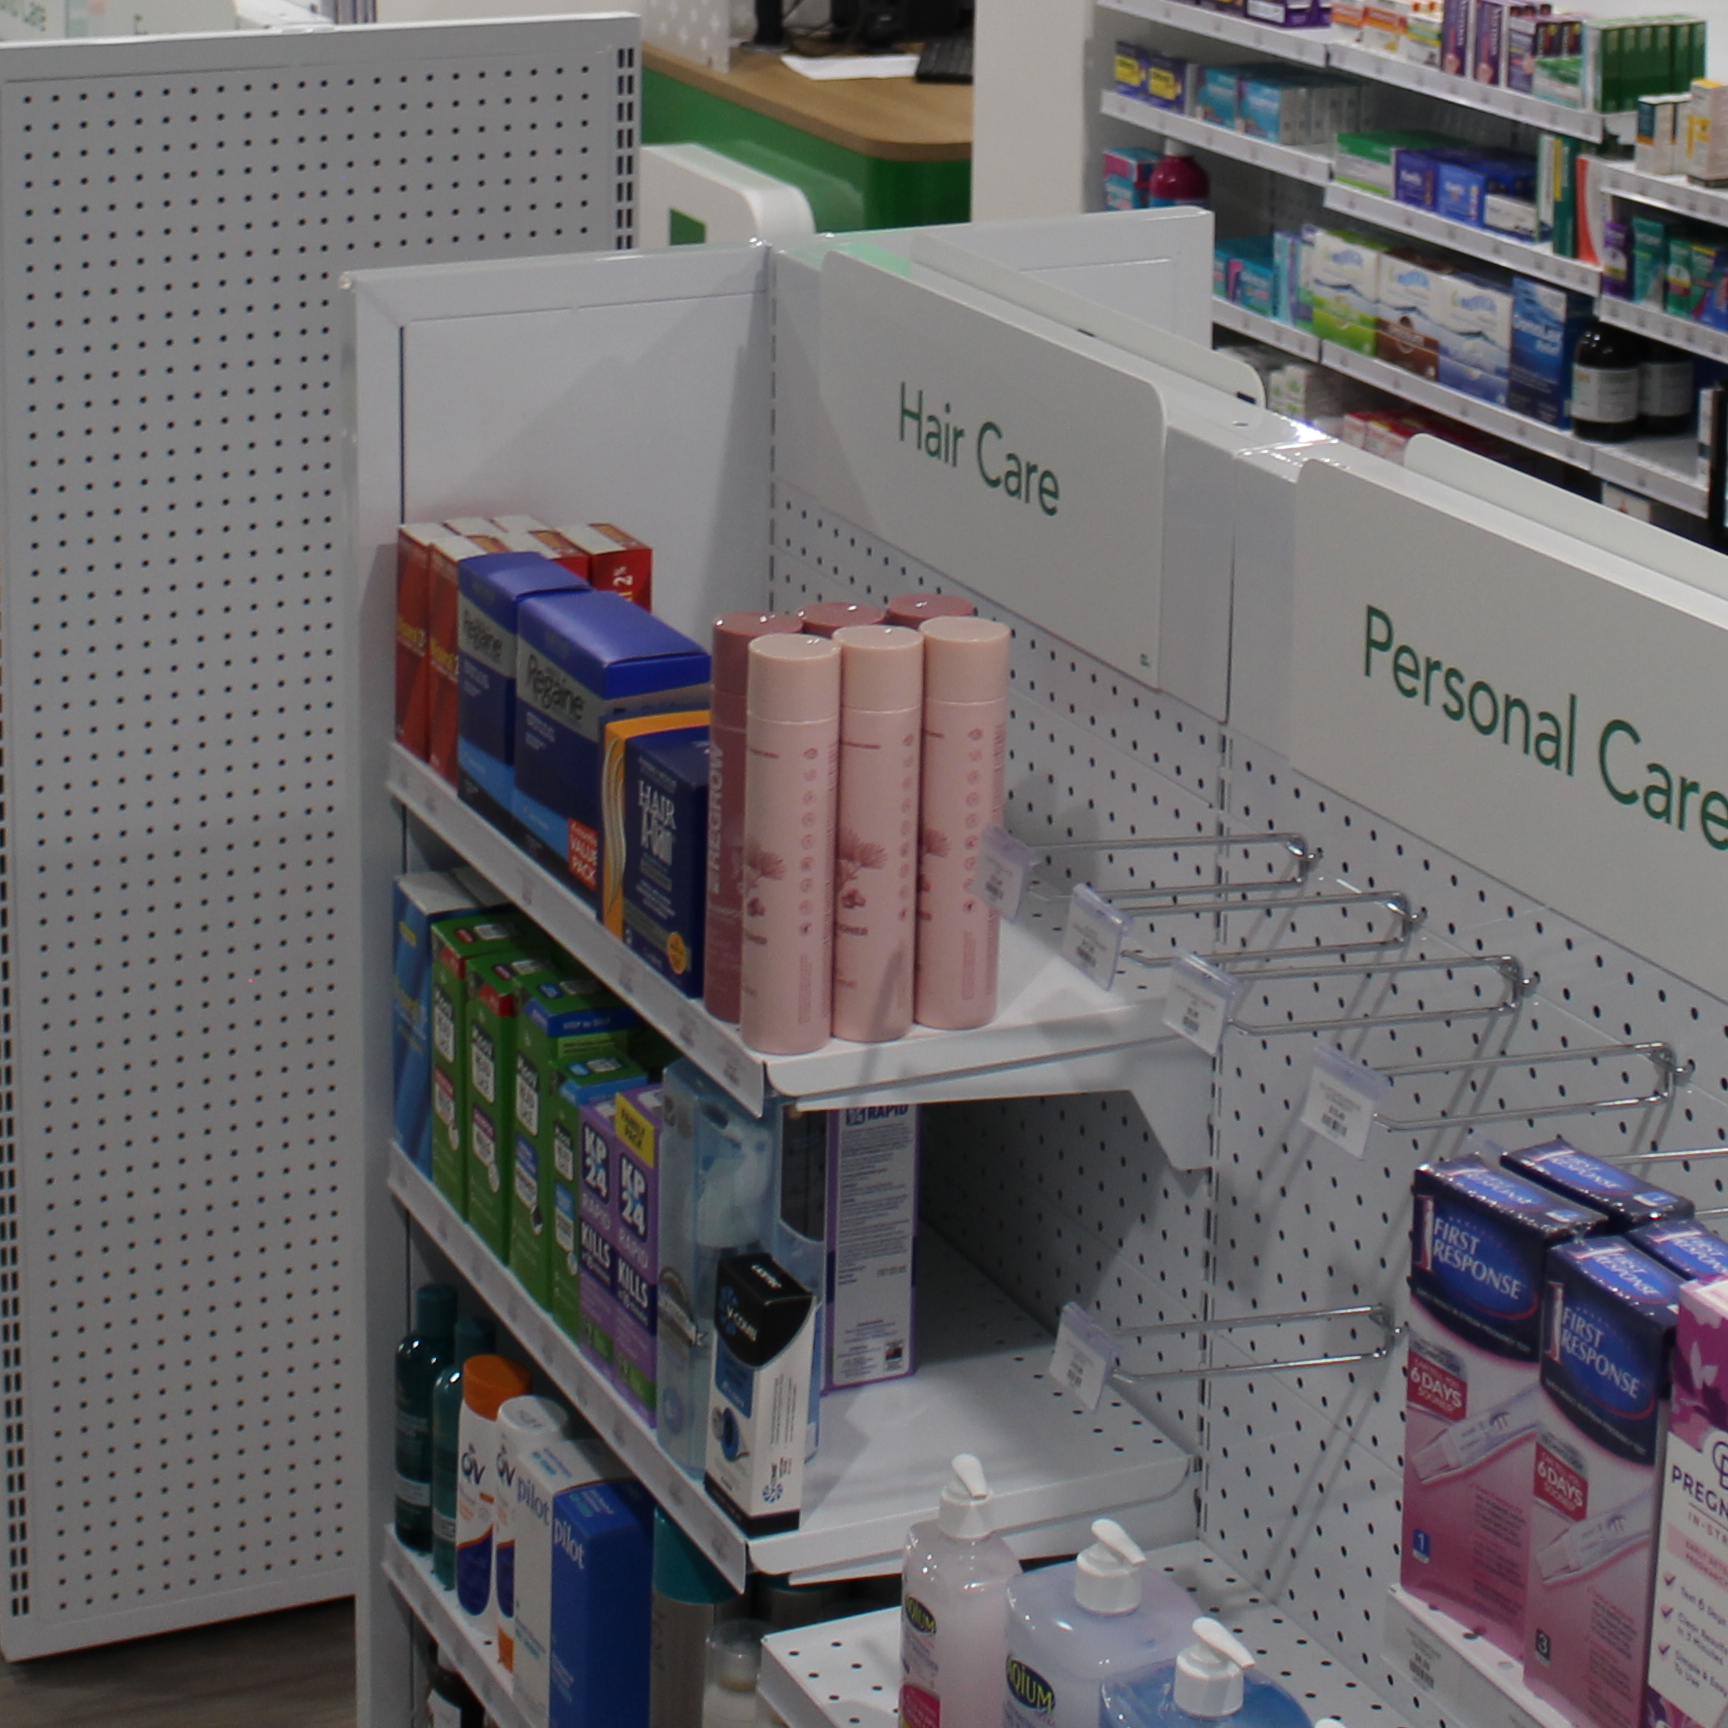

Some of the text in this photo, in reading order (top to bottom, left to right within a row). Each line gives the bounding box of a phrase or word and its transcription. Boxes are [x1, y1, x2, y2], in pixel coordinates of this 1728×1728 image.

[899, 381, 1060, 516] Hair Care
[526, 654, 586, 723] Regaine
[1364, 604, 1577, 777] Personal
[584, 1124, 608, 1161] KP
[585, 1157, 608, 1199] 24
[621, 1157, 646, 1195] KP
[622, 1196, 645, 1236] 24
[1434, 1217, 1480, 1256] FIRST
[581, 1222, 611, 1269] KILLS
[618, 1258, 649, 1308] KILLS
[1433, 1241, 1522, 1300] RESPONSE
[1563, 1306, 1604, 1347] FIRST
[1561, 1329, 1641, 1399] RESPONSE
[1411, 1367, 1462, 1409] 6 DAYS
[517, 1476, 551, 1526] pilot
[1538, 1461, 1584, 1508] 6 DAYS
[553, 1518, 585, 1570] pilot
[1417, 1532, 1426, 1550] 1
[1536, 1632, 1549, 1657] 3
